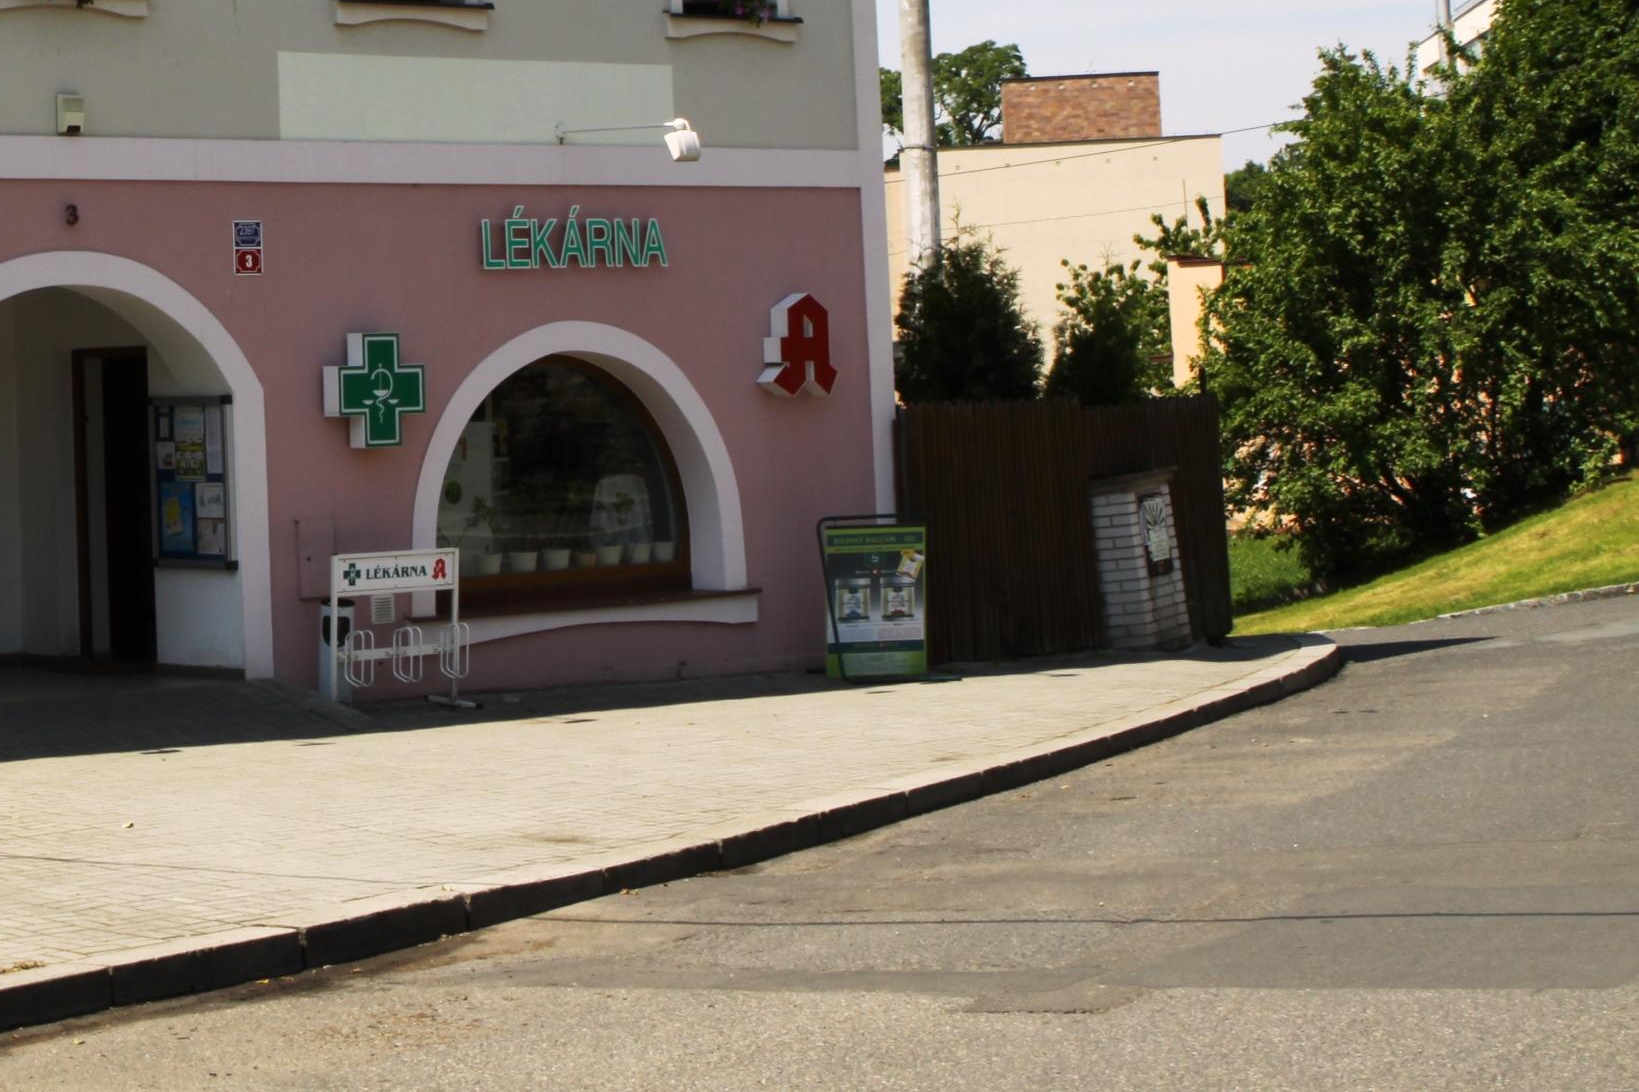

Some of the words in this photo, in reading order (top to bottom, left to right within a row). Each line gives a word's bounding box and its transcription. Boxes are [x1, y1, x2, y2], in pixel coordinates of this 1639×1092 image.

[65, 204, 79, 226] 3
[481, 205, 669, 269] LÉKÁRNA
[245, 254, 253, 268] 3
[770, 292, 838, 396] A
[366, 564, 427, 580] LÉKÁRNA
